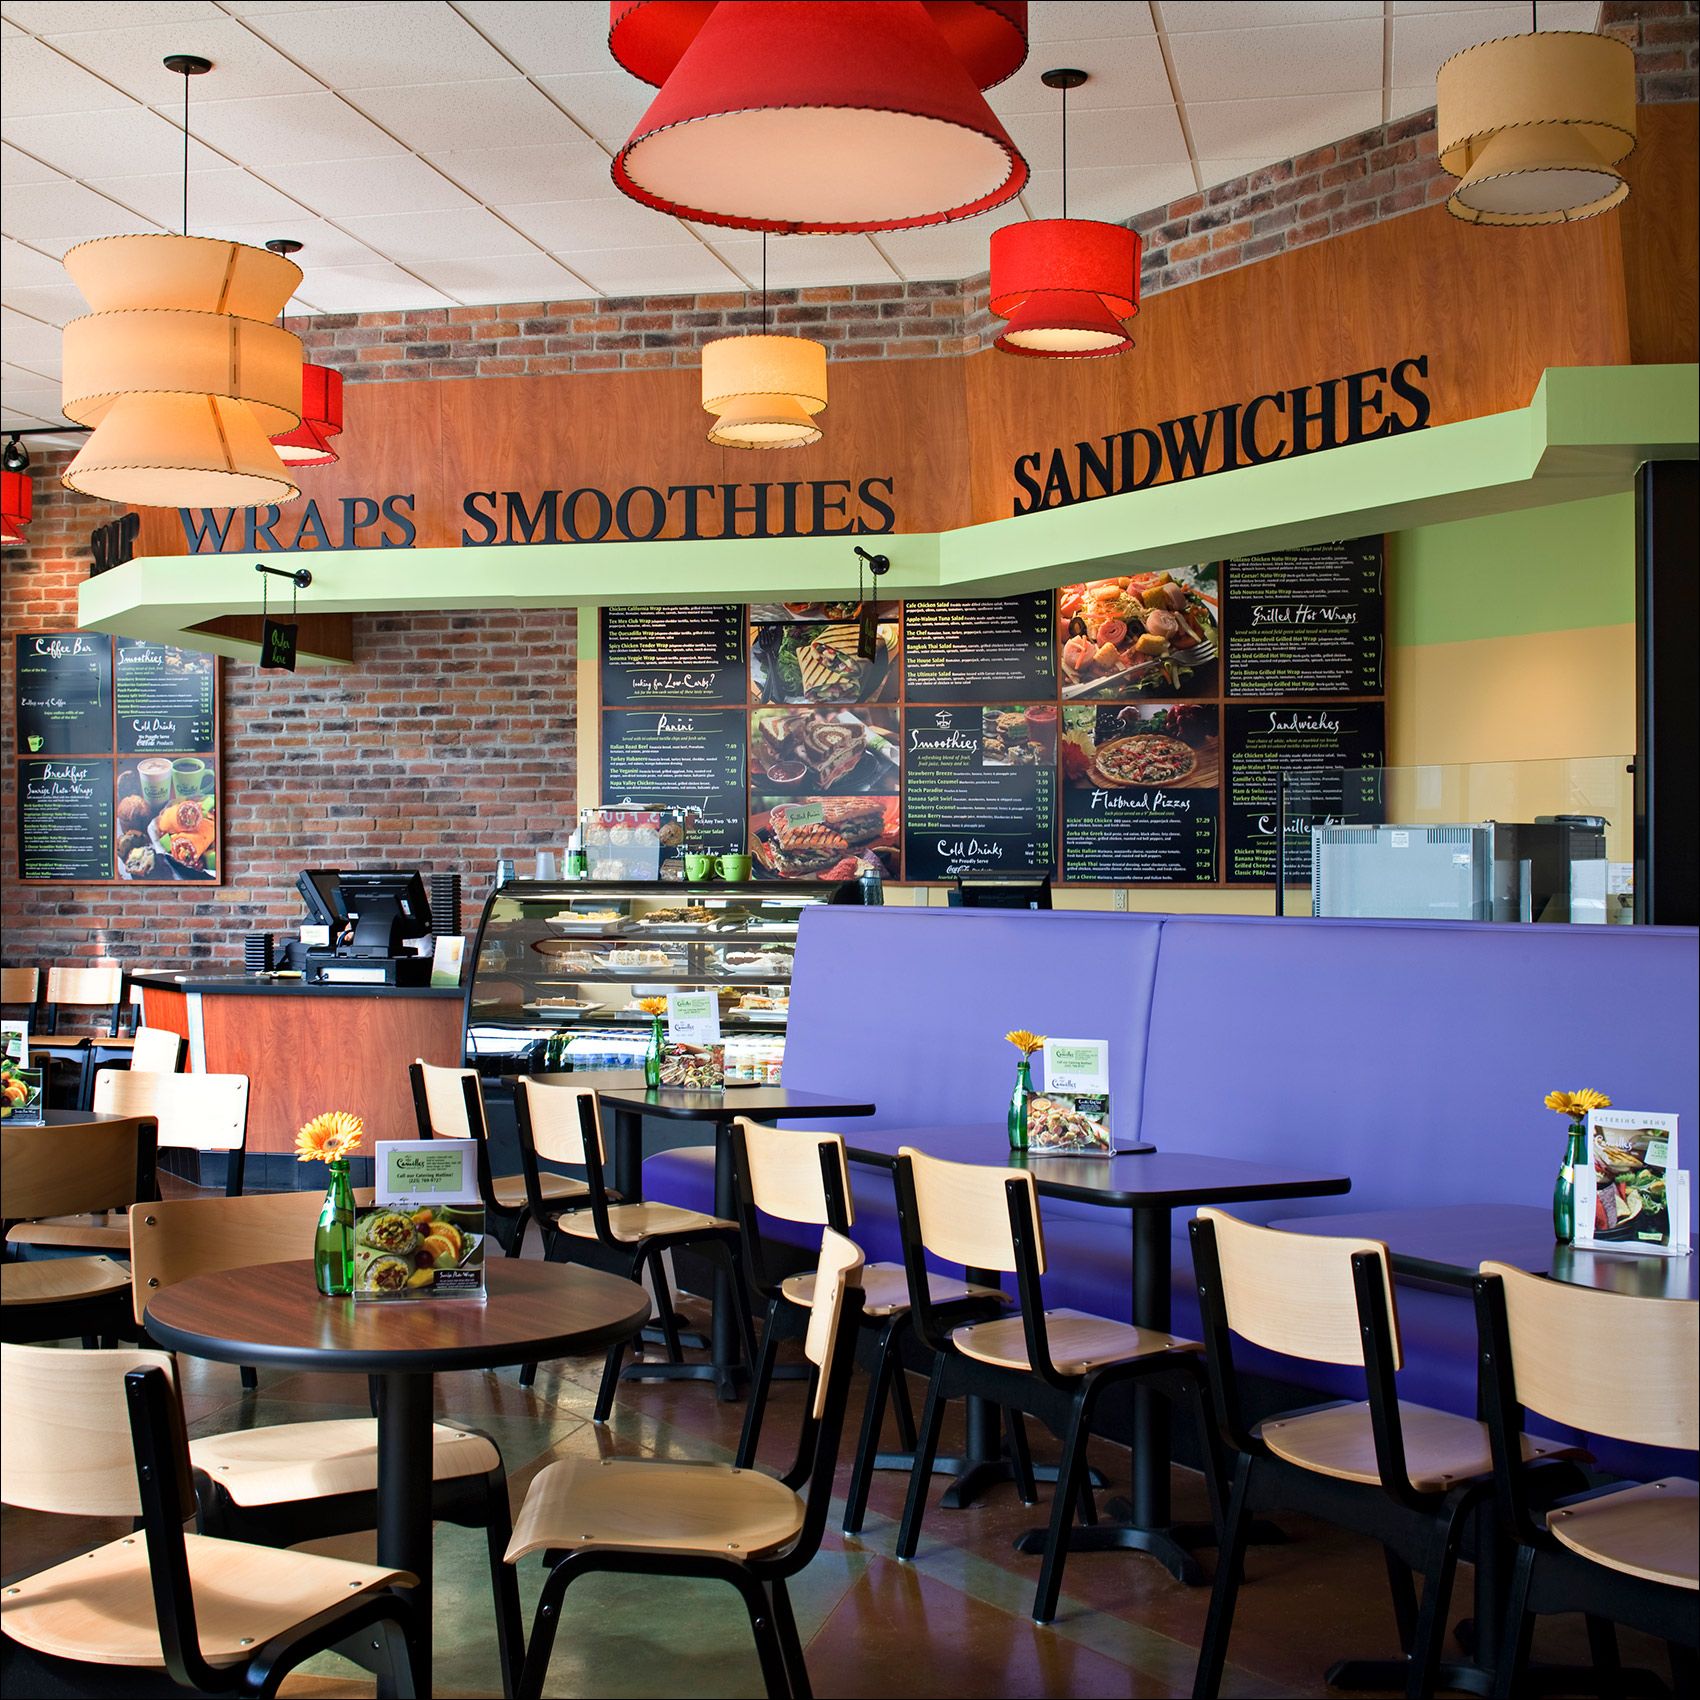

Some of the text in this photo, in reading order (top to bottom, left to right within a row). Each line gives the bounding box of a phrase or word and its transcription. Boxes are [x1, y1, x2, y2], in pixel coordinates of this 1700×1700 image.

[1014, 355, 1430, 517] SANDWICHES
[463, 476, 895, 547] SMOOTHIES
[180, 494, 416, 554] WRAPS
[1251, 604, 1357, 626] Grilled Hot Wraps
[36, 637, 92, 659] Coffee Bar
[118, 649, 163, 666] Smoothies
[133, 718, 176, 732] Cold Drinks
[657, 713, 694, 735] Panini
[1268, 711, 1339, 734] Sandwiches
[910, 729, 977, 754] Smoothies
[43, 764, 88, 783] Breakfast
[1091, 789, 1191, 812] Flatbread Pizzas
[937, 838, 1003, 859] Cold Drinks
